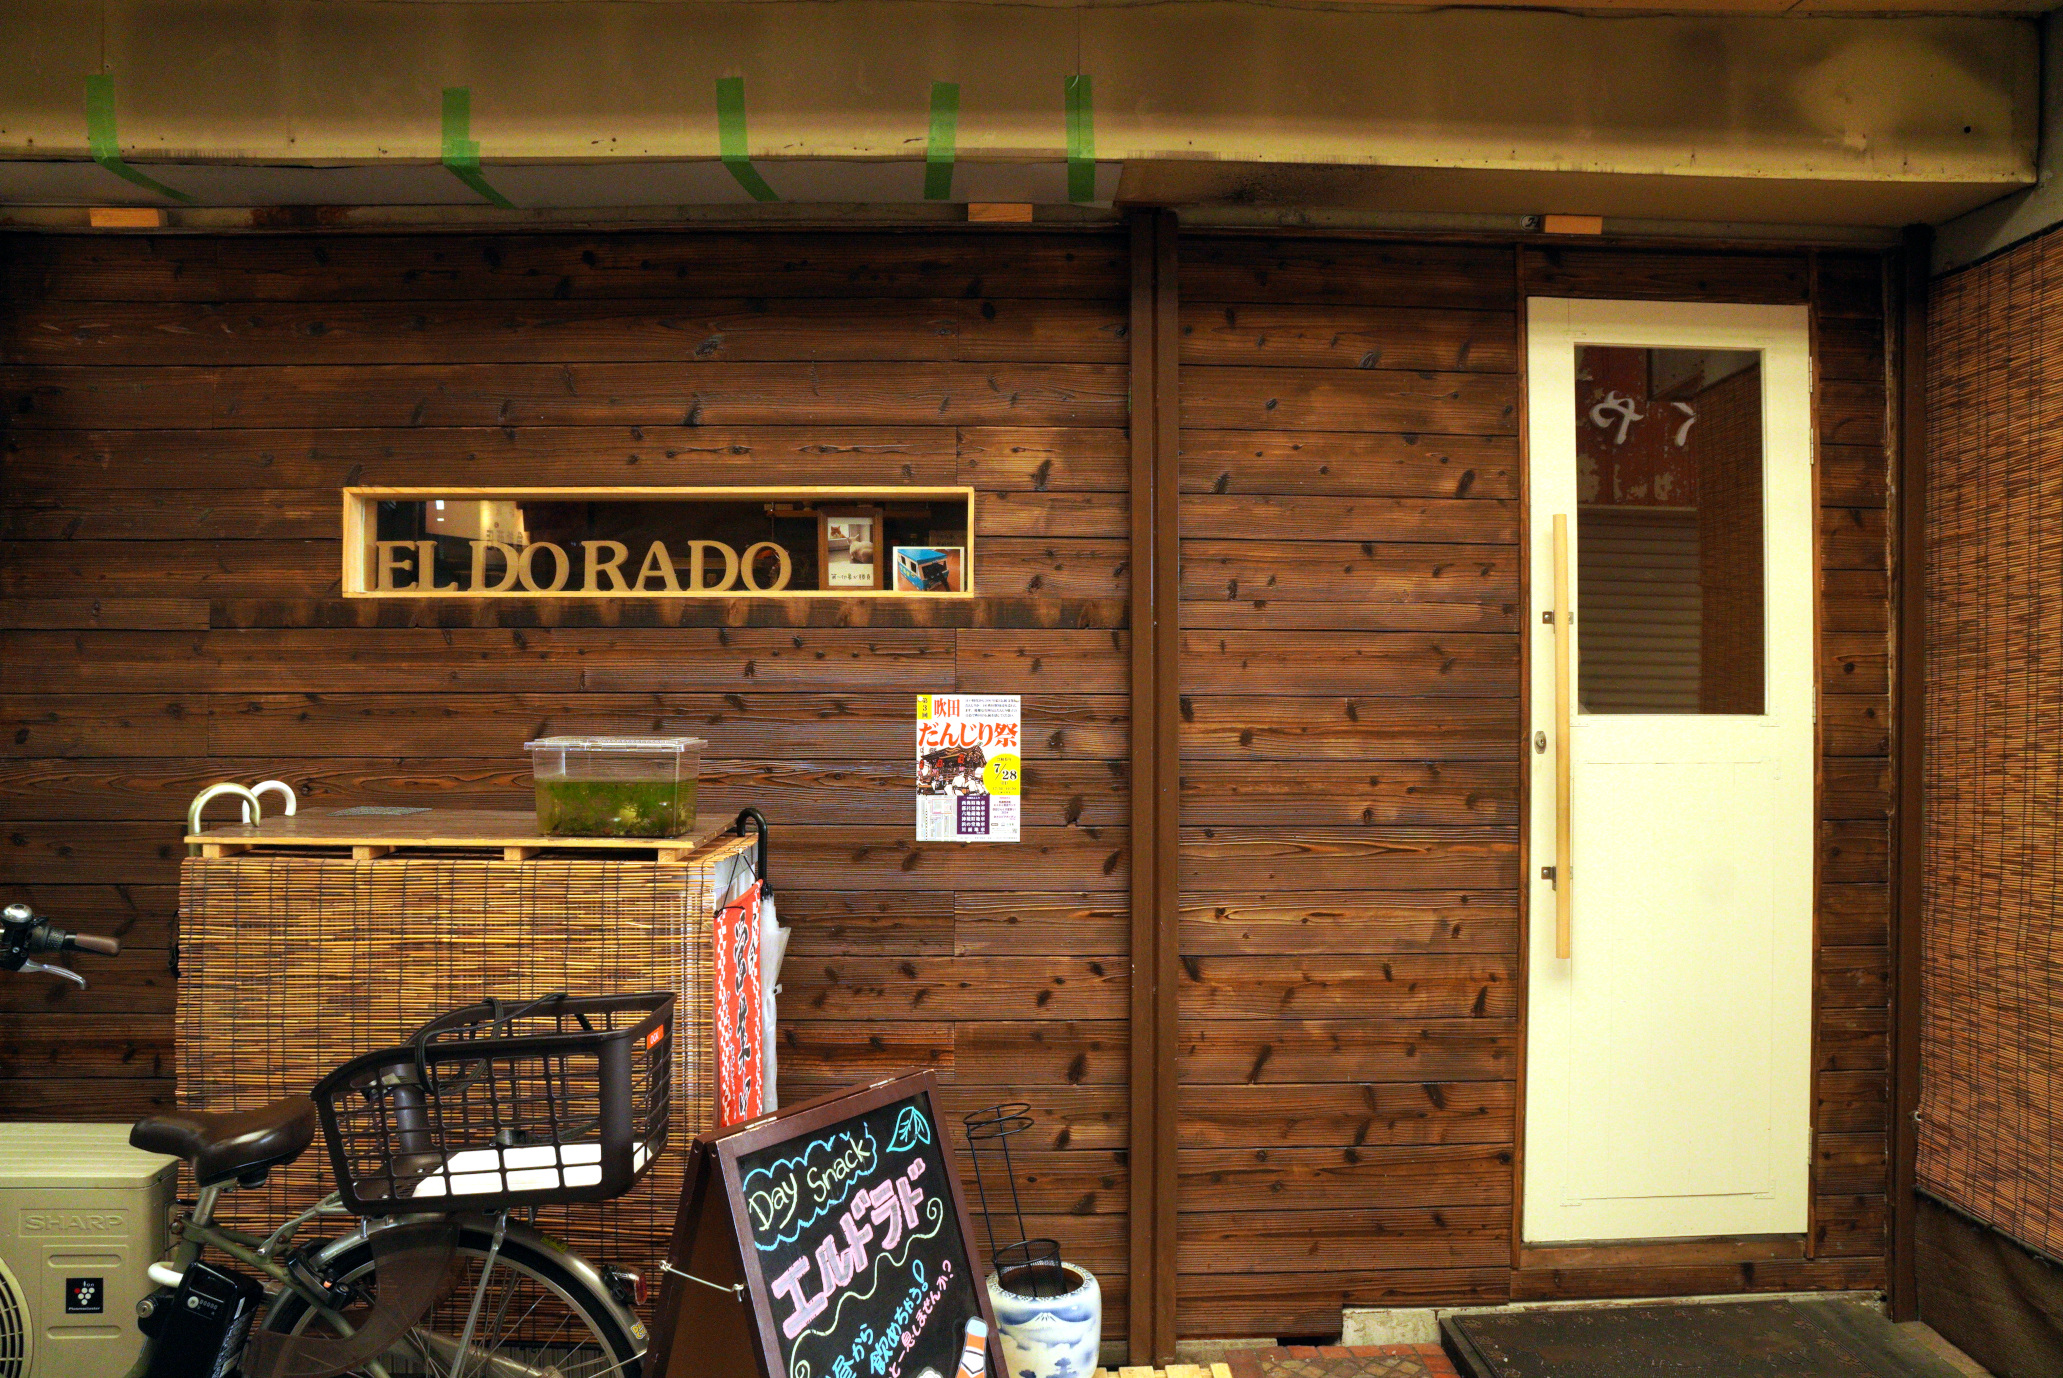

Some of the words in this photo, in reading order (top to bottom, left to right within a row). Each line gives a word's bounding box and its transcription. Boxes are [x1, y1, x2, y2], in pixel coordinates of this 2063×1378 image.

[934, 698, 960, 718] 吹田
[918, 722, 1019, 747] だんじり祭
[994, 763, 1017, 780] 7/28
[749, 1173, 797, 1231] Day
[807, 1137, 871, 1202] Snack
[25, 1215, 123, 1231] SHARP
[771, 1157, 926, 1340] エルドラド
[889, 1259, 954, 1378] と一息しませんか?
